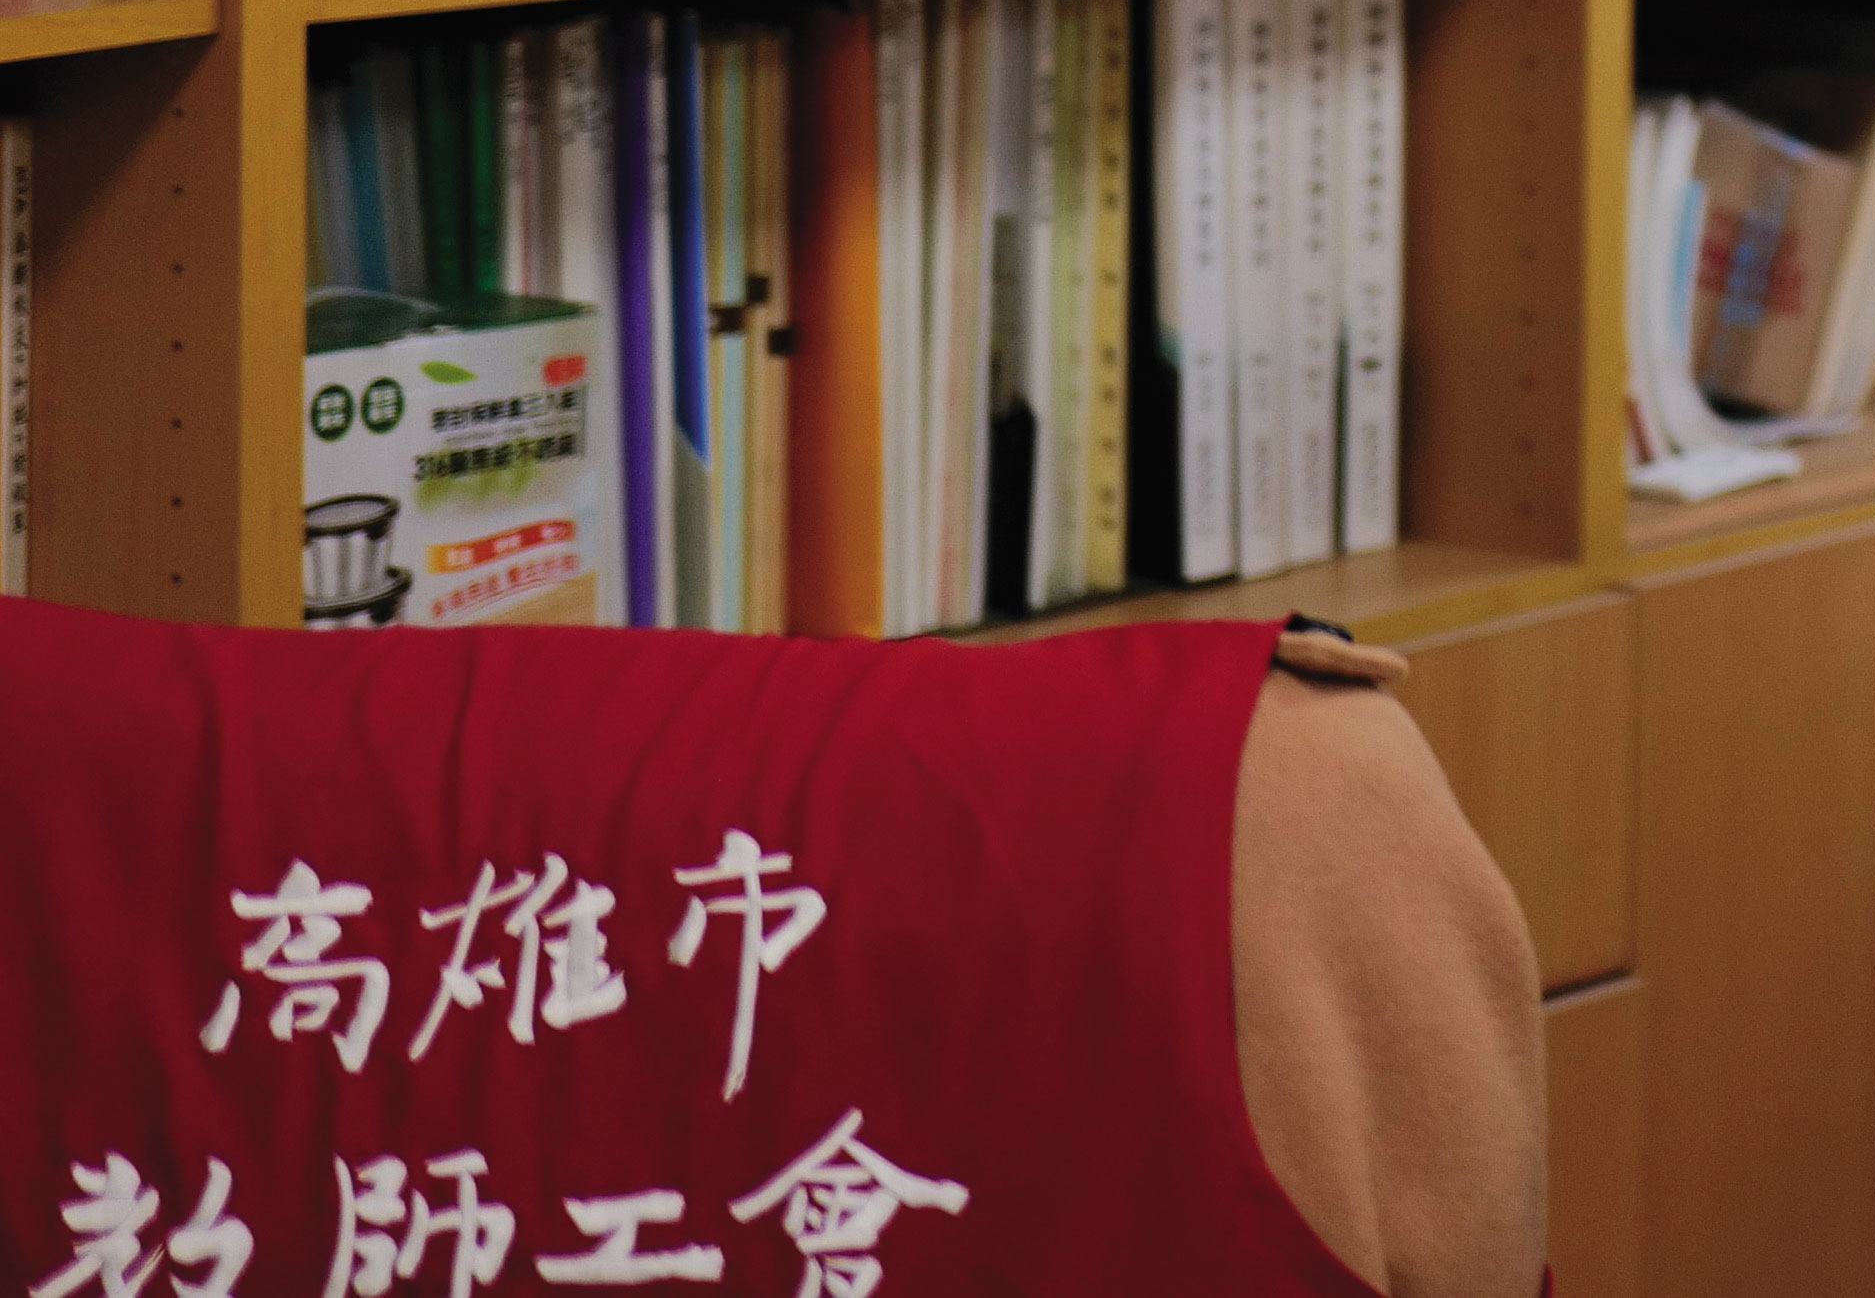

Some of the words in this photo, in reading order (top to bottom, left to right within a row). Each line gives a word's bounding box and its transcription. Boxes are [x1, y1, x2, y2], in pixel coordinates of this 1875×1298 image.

[200, 826, 828, 1103] 高雄市
[27, 1107, 970, 1298] 教師工會
